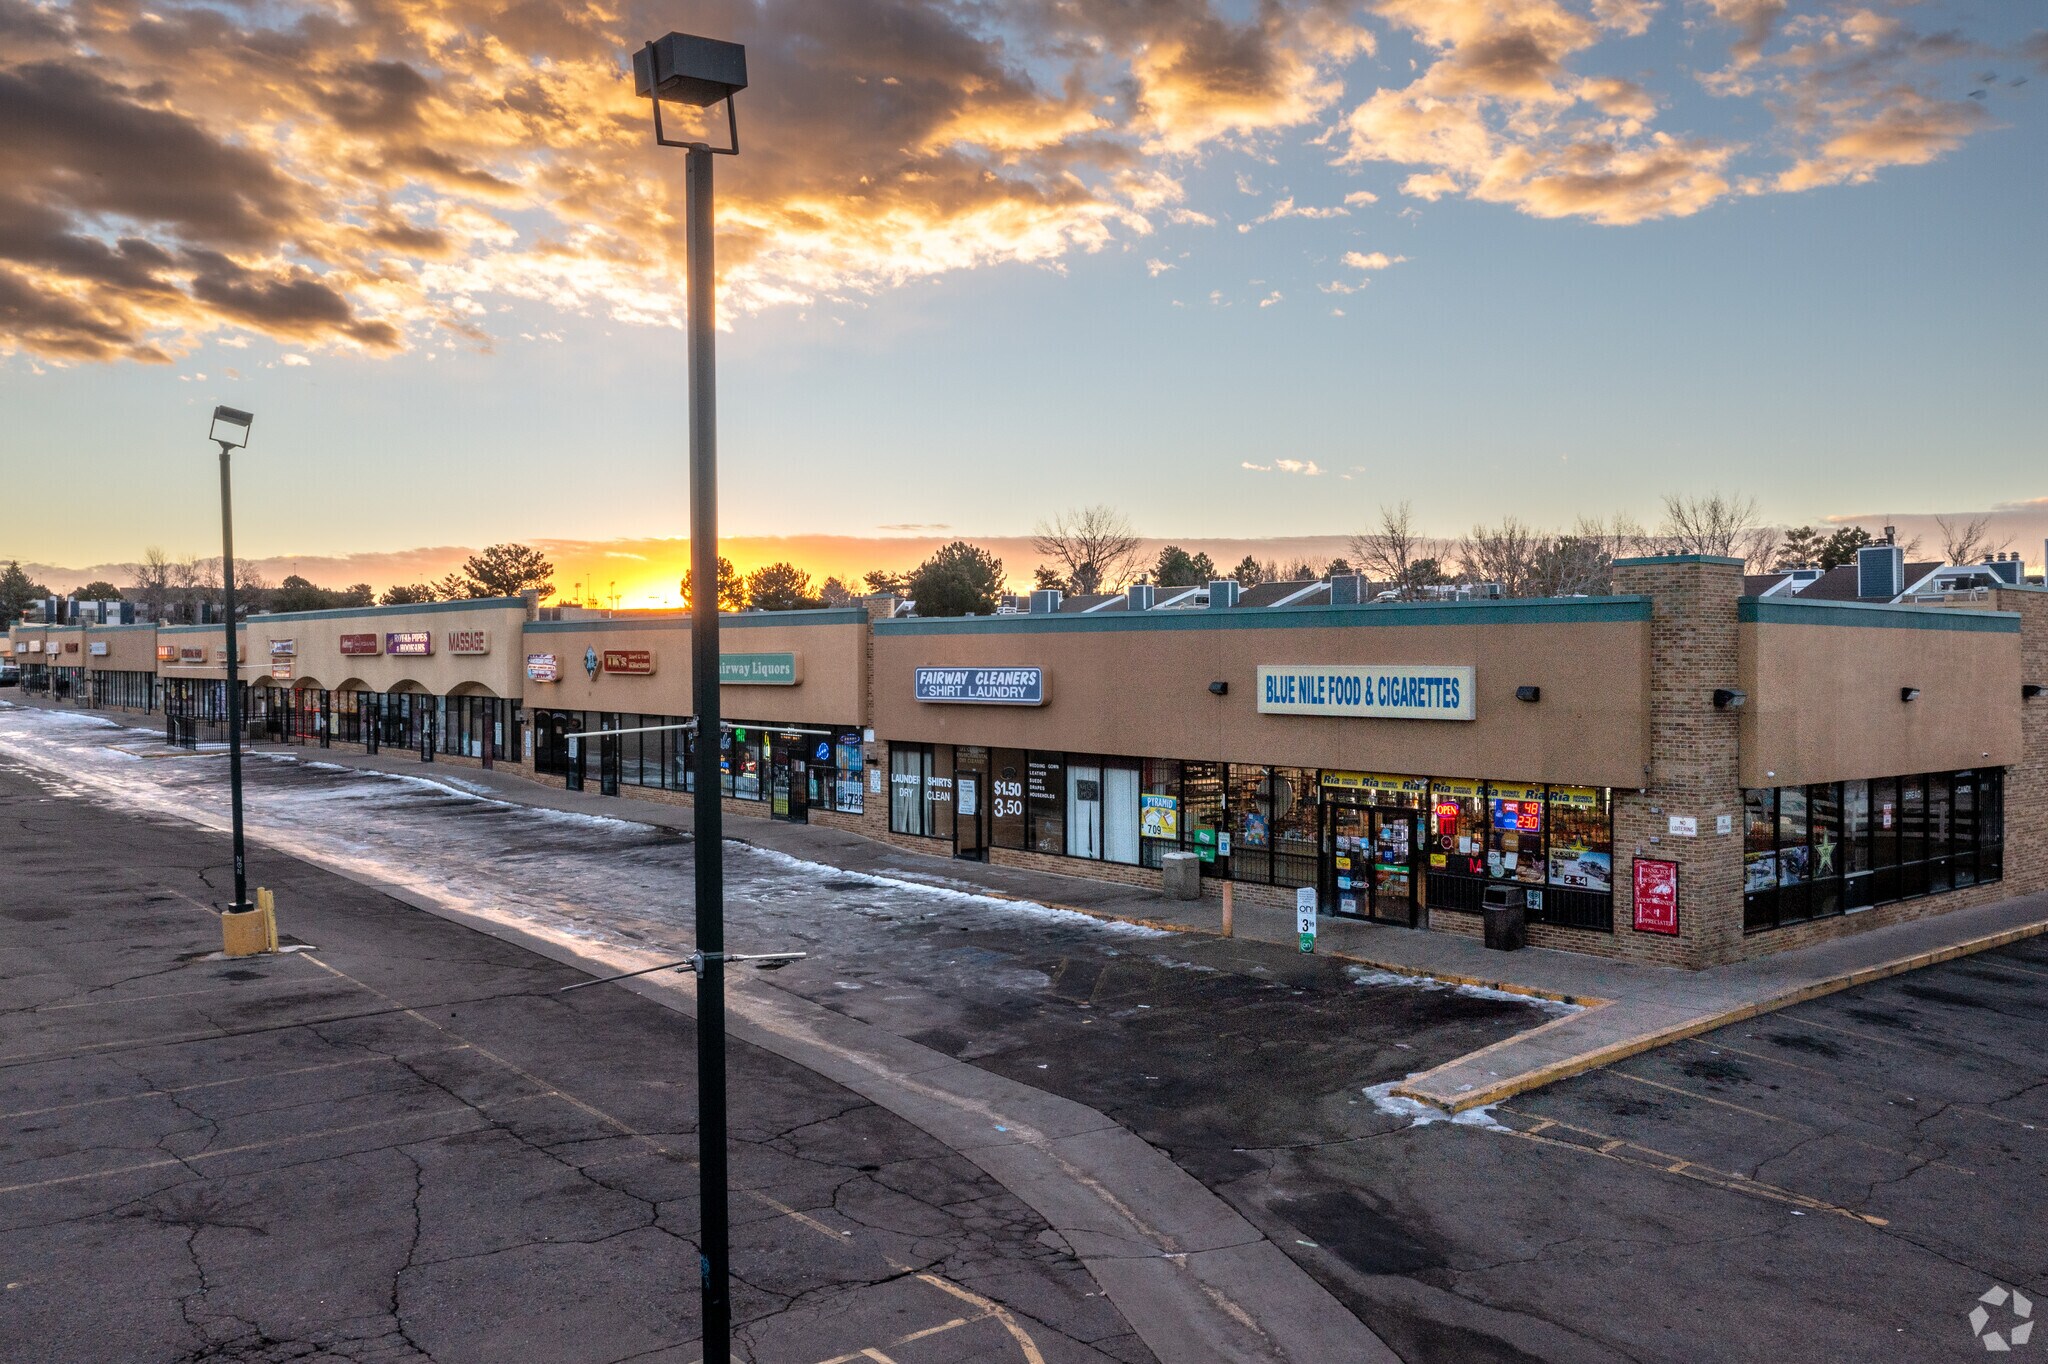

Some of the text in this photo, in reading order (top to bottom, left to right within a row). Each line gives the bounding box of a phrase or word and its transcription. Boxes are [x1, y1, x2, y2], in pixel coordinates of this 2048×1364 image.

[411, 633, 428, 643] PIPES
[448, 631, 484, 651] MASSAGE
[719, 662, 790, 677] airway Liquors
[919, 671, 1037, 686] FAIRWAY CLEANERS
[928, 685, 962, 697] SHIRT
[968, 686, 1026, 698] LAUNDRY
[1266, 675, 1460, 708] BLUE NILE FOOD & CIGARETTES
[891, 773, 921, 785] LAUNDER
[927, 776, 952, 788] SHIRTS
[1323, 773, 1340, 785] Ria
[1362, 775, 1379, 788] Ria
[1402, 779, 1420, 791] Ria
[994, 780, 1022, 797] $1.50
[1432, 780, 1451, 793] Ria
[899, 787, 951, 802] DRY CLEAN
[1525, 787, 1546, 800] Ria
[1550, 789, 1570, 802] Ria
[993, 798, 1022, 817] 3.50
[1147, 797, 1173, 809] PYRAMID
[1525, 802, 1539, 815] 48
[1437, 805, 1457, 815] OPEN
